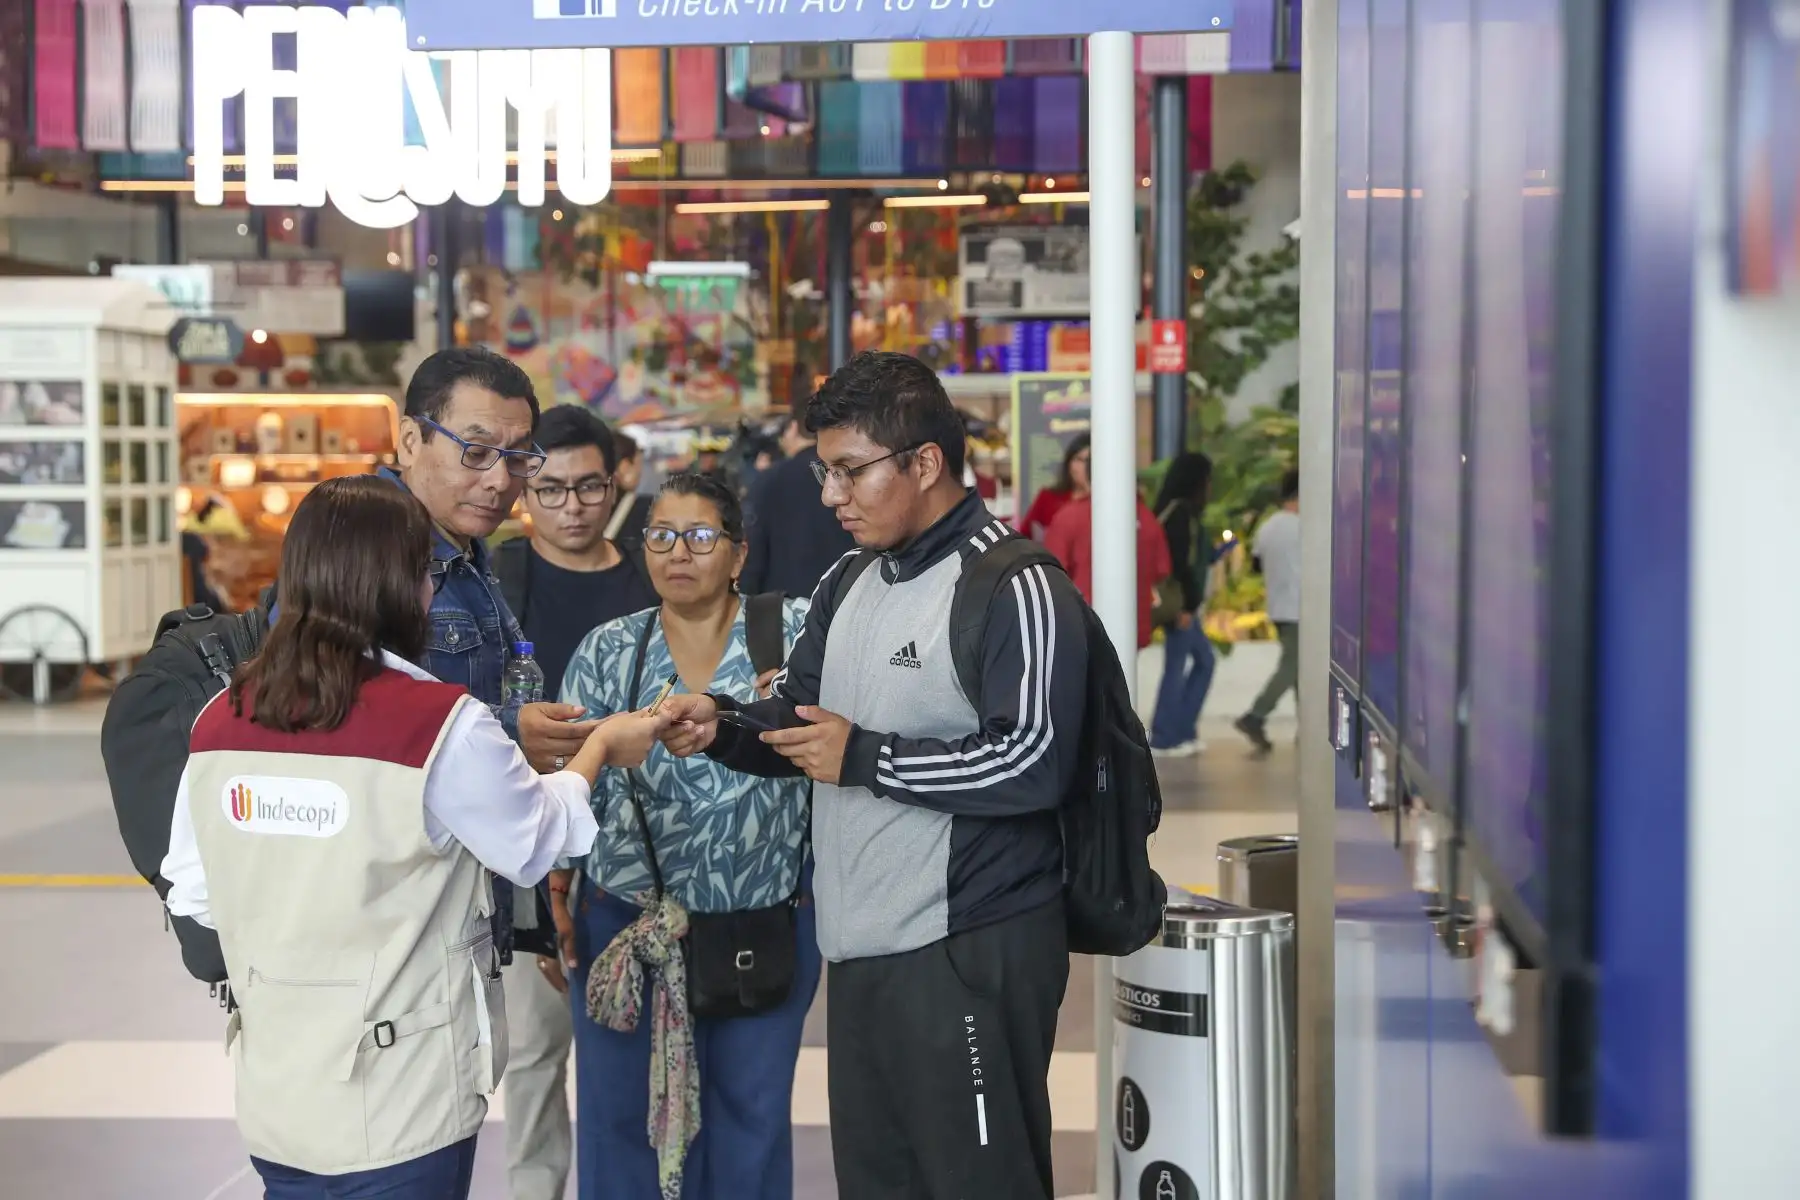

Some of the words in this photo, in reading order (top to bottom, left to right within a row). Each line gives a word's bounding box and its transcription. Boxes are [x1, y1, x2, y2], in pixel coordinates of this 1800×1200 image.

[890, 656, 921, 668] adidas
[257, 795, 336, 831] Indecopi
[1115, 984, 1160, 1007] STICOS
[964, 1015, 983, 1086] BALANCE
